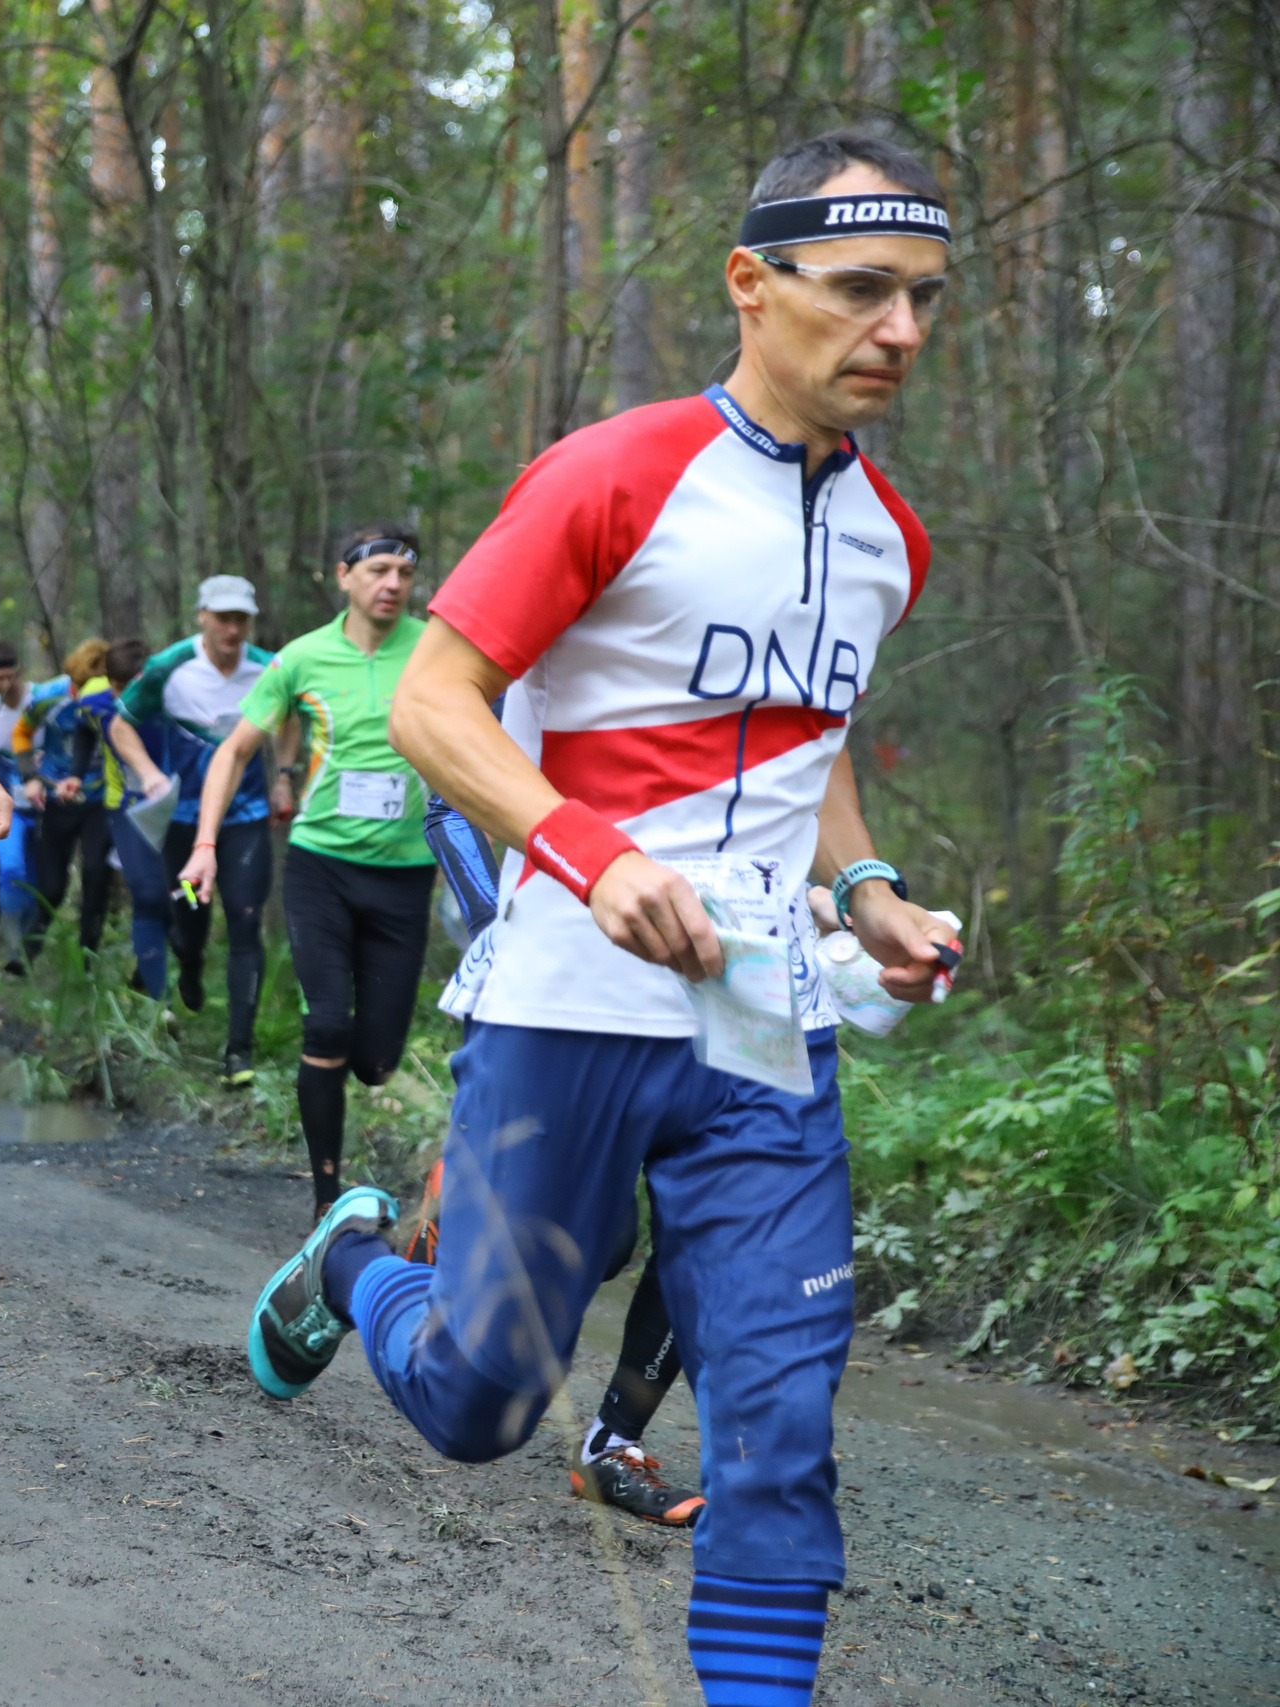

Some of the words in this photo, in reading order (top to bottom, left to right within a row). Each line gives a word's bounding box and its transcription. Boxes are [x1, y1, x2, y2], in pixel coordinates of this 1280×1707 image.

[715, 397, 781, 456] noname
[838, 532, 884, 558] noname
[688, 623, 859, 717] DNB
[383, 800, 402, 816] 17
